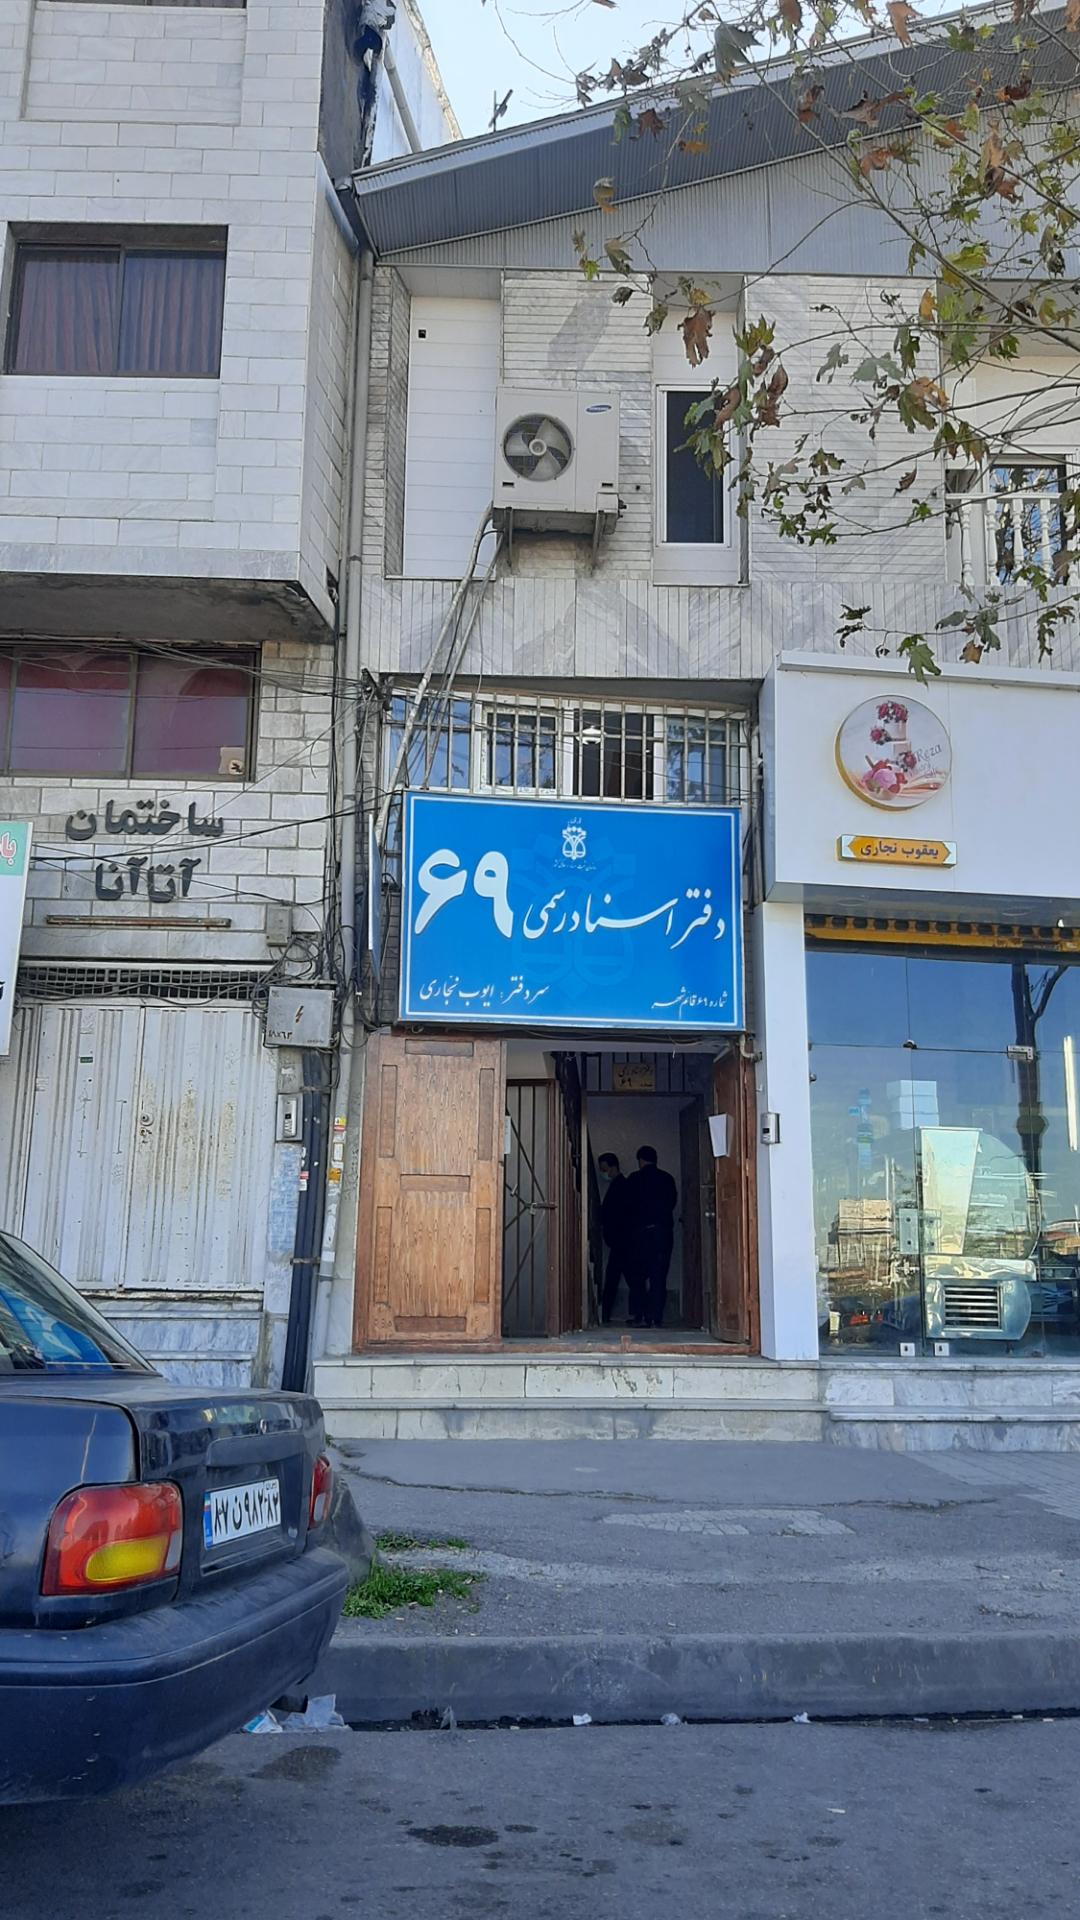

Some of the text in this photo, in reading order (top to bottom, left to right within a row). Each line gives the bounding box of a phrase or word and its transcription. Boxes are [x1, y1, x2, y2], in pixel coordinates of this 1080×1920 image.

[914, 744, 942, 762] Reza
[65, 799, 224, 841] ساختمان
[860, 841, 939, 859] یعقوب نجاری
[414, 848, 726, 950] دفتر اسناد رسمی ۶۹
[419, 975, 460, 1006] نجاری
[458, 983, 495, 1007] ایوب
